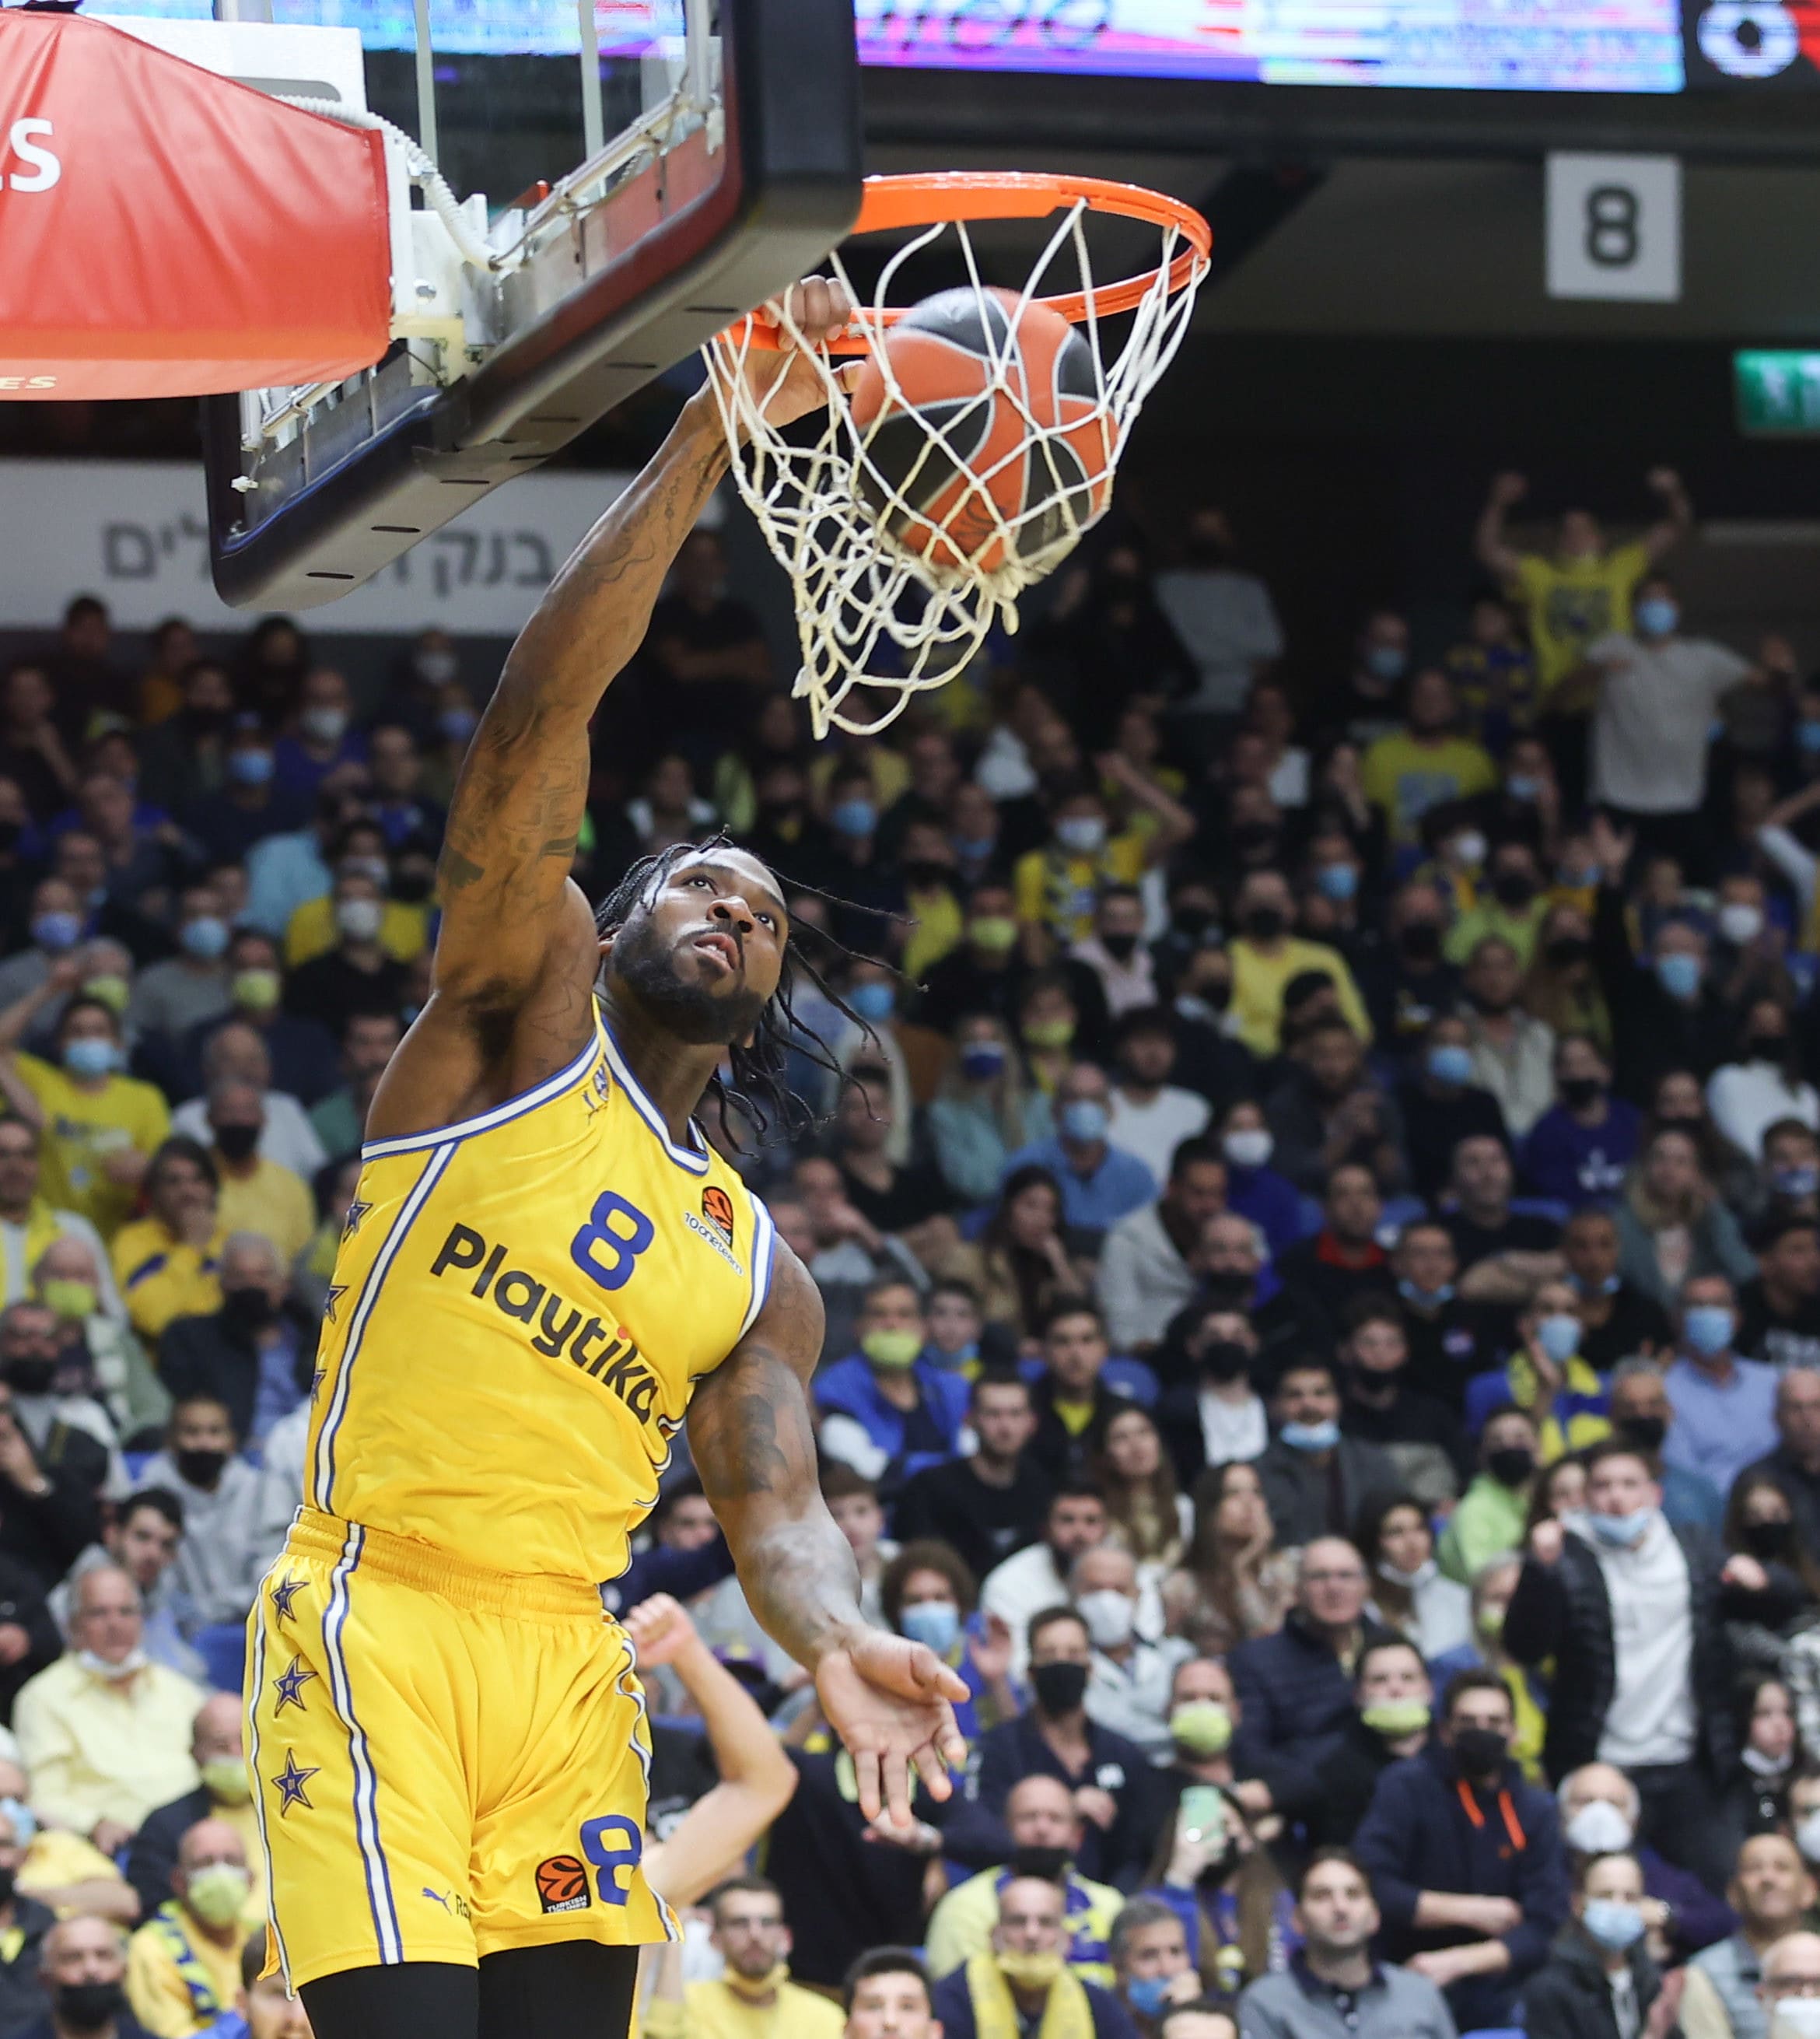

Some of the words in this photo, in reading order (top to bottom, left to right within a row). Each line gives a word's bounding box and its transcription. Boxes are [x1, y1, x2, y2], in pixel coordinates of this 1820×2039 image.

[0, 117, 61, 192] S
[1586, 184, 1640, 268] 8
[431, 527, 557, 597] בנק
[570, 1190, 655, 1291] 8
[429, 1222, 658, 1425] Playtika
[579, 1814, 642, 1907] 8
